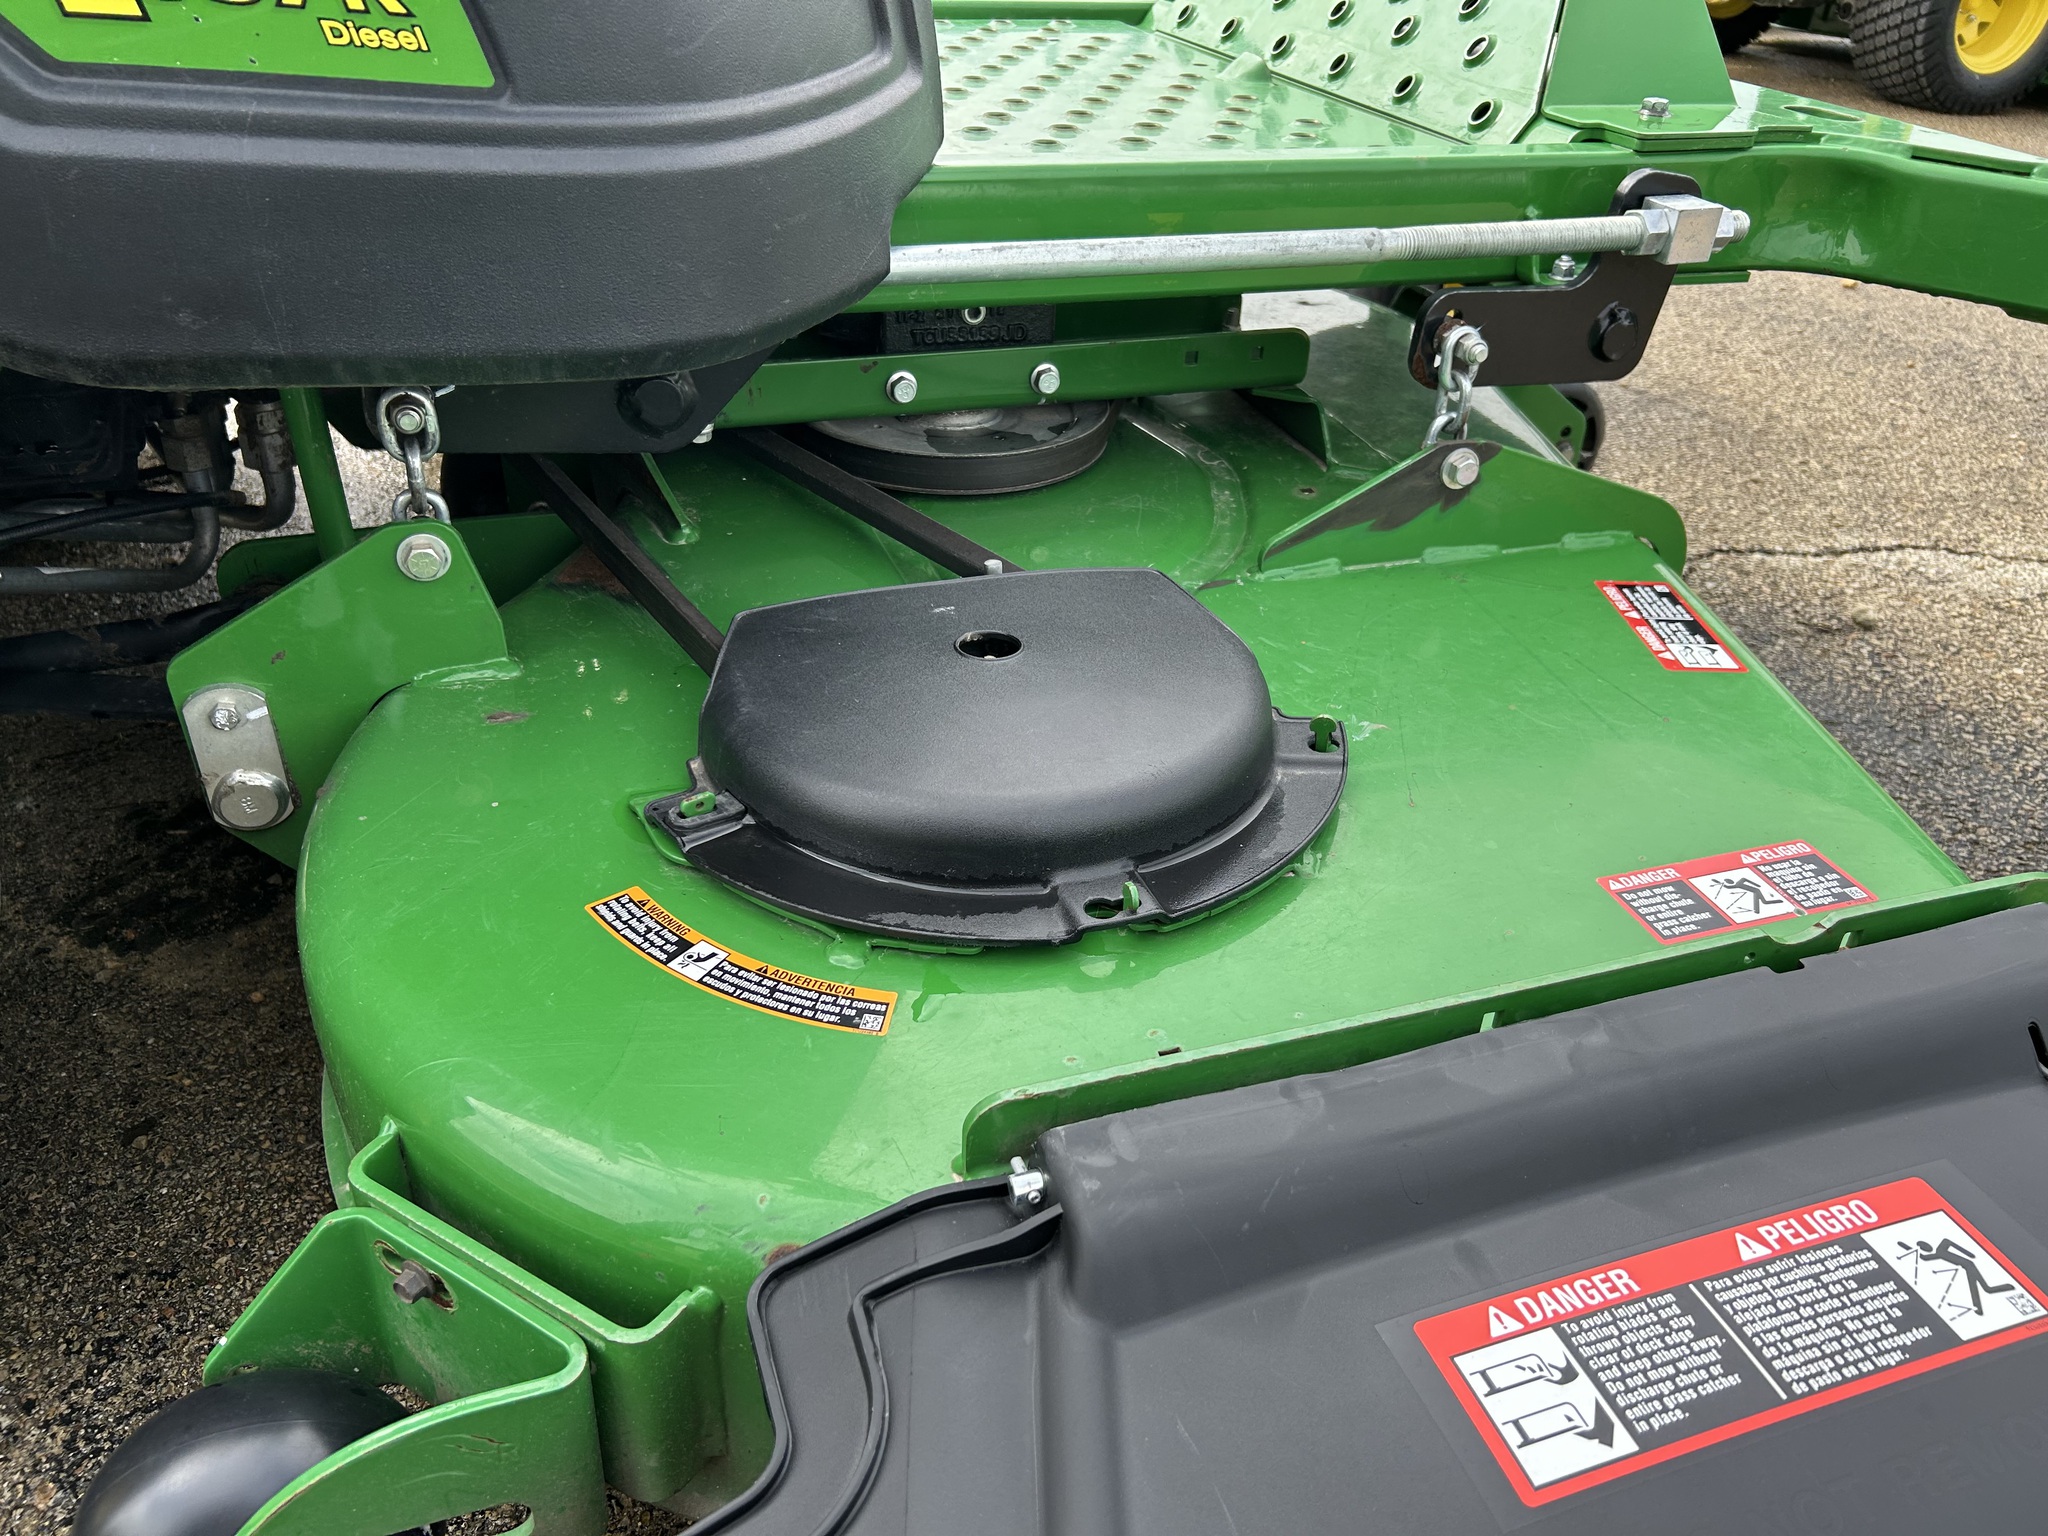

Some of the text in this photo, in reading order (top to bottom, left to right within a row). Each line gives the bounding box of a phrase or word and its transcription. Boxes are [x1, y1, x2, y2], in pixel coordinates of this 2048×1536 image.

[321, 19, 430, 53] Diesel
[1749, 842, 1811, 861] PELIGRO
[1618, 868, 1681, 887] DANGER
[1637, 889, 1654, 897] not
[1652, 886, 1675, 894] mow
[619, 895, 679, 942] To avoid injury from
[647, 904, 691, 936] WARNING
[1630, 895, 1665, 907] without
[1638, 898, 1694, 914] charge chute
[1653, 912, 1712, 930] grass catcher
[1656, 909, 1684, 919] entire
[595, 904, 667, 961] shields and guards in place.
[607, 900, 677, 952] rotating belts, keep all
[1659, 924, 1701, 936] in place.
[702, 976, 736, 993] escudos
[739, 991, 789, 1010] protectores
[789, 1006, 802, 1014] en
[815, 1011, 840, 1023] lugar.
[711, 969, 856, 1016] en movimiento, mantener todos los
[718, 961, 886, 1011] Para evitar ser lesionado por las correas
[770, 968, 856, 997] ADVERTENCIA
[1757, 1200, 1878, 1250] PELIGRO
[1703, 1245, 1843, 1291] Para evitar sufrir lesiones
[1714, 1249, 1872, 1302] causadas por cuchillas giratorias
[1723, 1260, 1878, 1315] y objetos lanzados, mantenerse
[1514, 1269, 1640, 1324] DANGER
[1560, 1293, 1676, 1334] To avoid injury from
[1730, 1279, 1858, 1324] alejado del borde de la
[1742, 1281, 1897, 1337] plataforma de corte y mantener
[1752, 1291, 1909, 1346] a las demás personas alejadas
[1571, 1303, 1681, 1346] rotating blades and
[1578, 1315, 1695, 1357] thrown objects, stay
[1762, 1307, 1902, 1358] de la máquina. No usar la
[1771, 1323, 1897, 1370] máquina sin el tubo de
[1589, 1329, 1694, 1369] clear of deck edge
[1597, 1335, 1726, 1381] and keep others away.
[1605, 1348, 1721, 1394] Do not mow without
[1781, 1326, 1932, 1382] descarga o sin el recogedor
[1616, 1364, 1723, 1407] discharge chute or
[1791, 1350, 1909, 1394] de pasto en su lugar.
[1625, 1373, 1741, 1419] entire grass catcher
[1632, 1407, 1689, 1433] in place.
